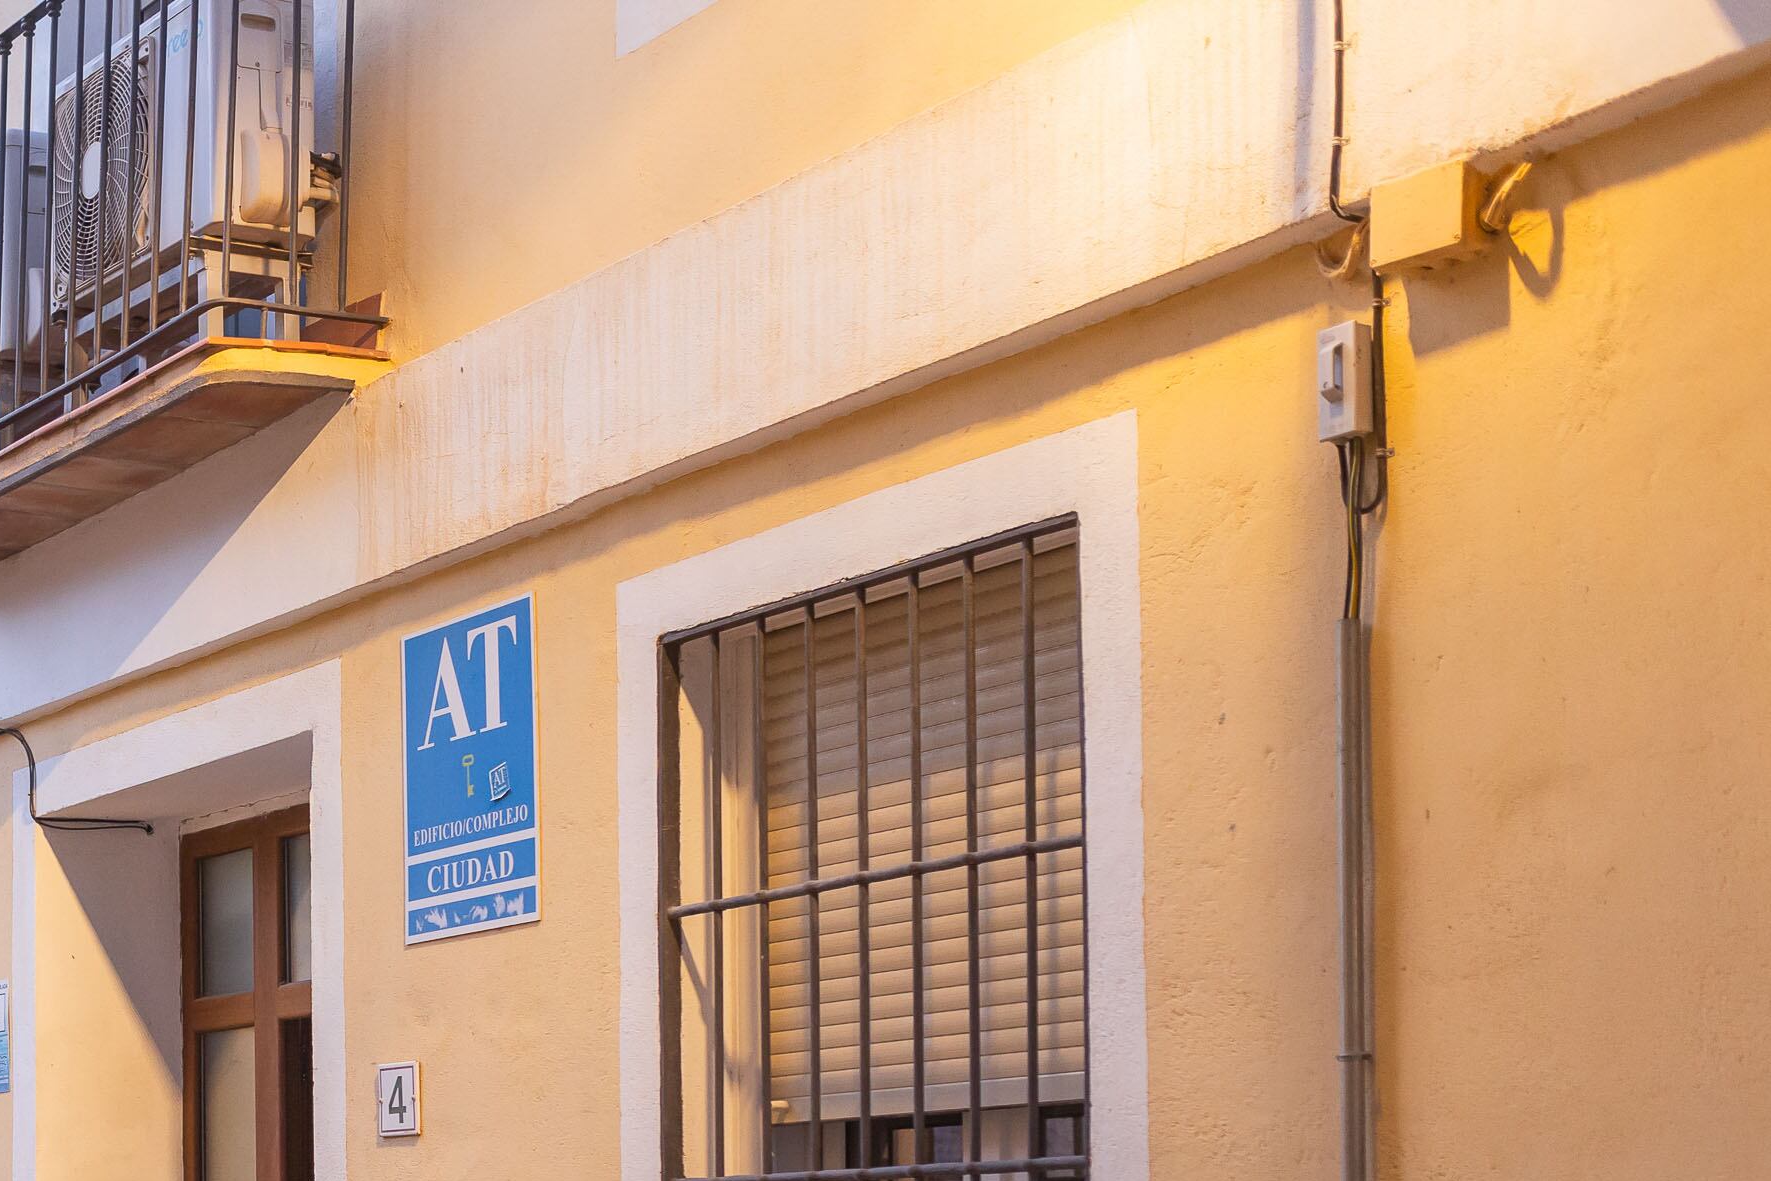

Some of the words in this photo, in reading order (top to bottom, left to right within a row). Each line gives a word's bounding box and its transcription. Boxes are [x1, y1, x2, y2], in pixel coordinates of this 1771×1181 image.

[417, 615, 517, 751] AT
[413, 803, 528, 847] EDIFICIO/COMPLEJO
[427, 850, 514, 893] CIUDAD
[388, 1075, 407, 1124] 4
